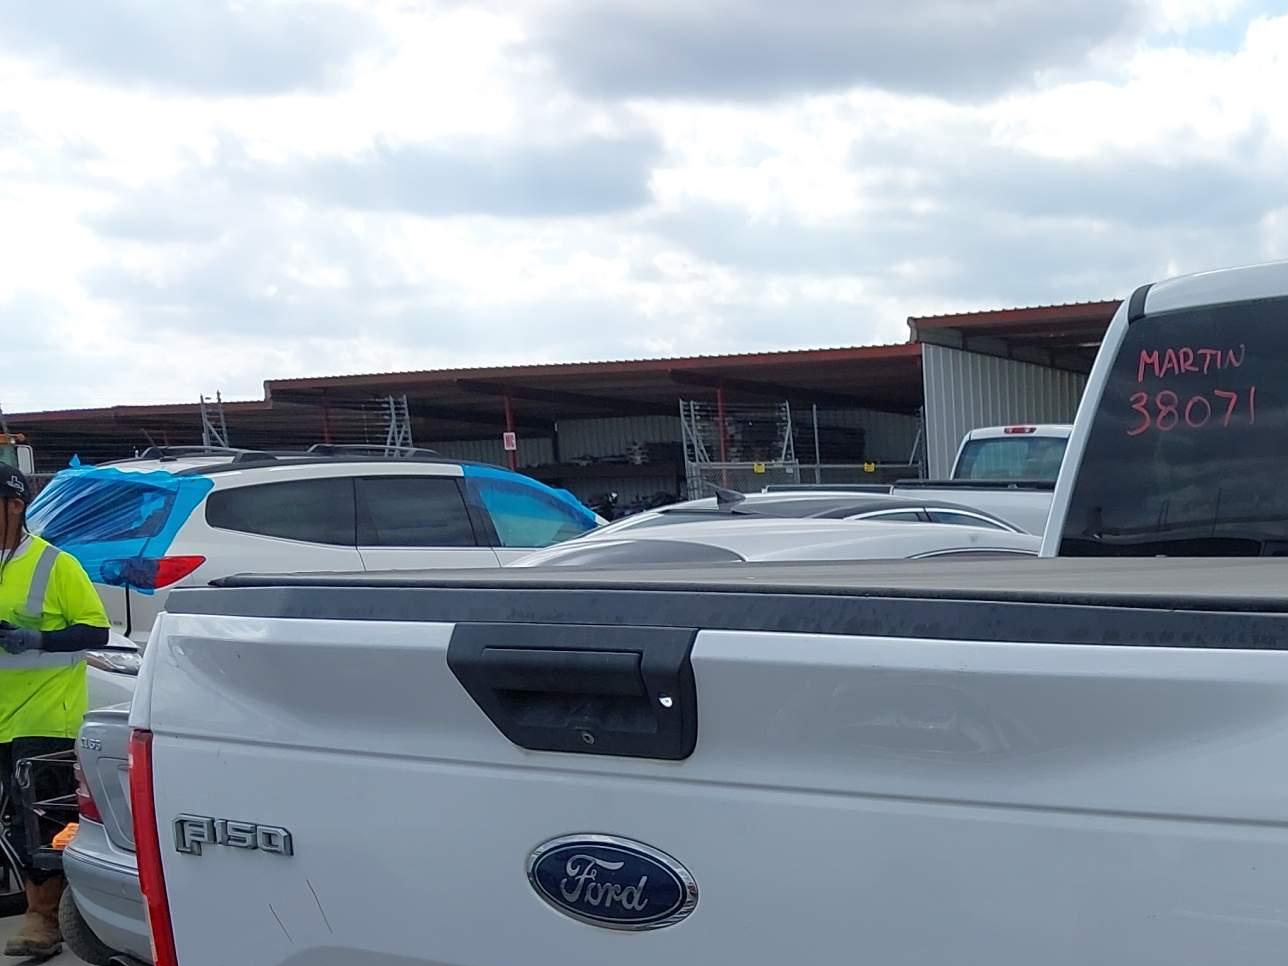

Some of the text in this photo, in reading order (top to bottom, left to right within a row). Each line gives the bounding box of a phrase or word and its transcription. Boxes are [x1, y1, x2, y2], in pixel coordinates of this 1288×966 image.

[1137, 343, 1246, 383] MARTIN
[1126, 386, 1256, 436] 38071
[560, 853, 649, 911] Ford
